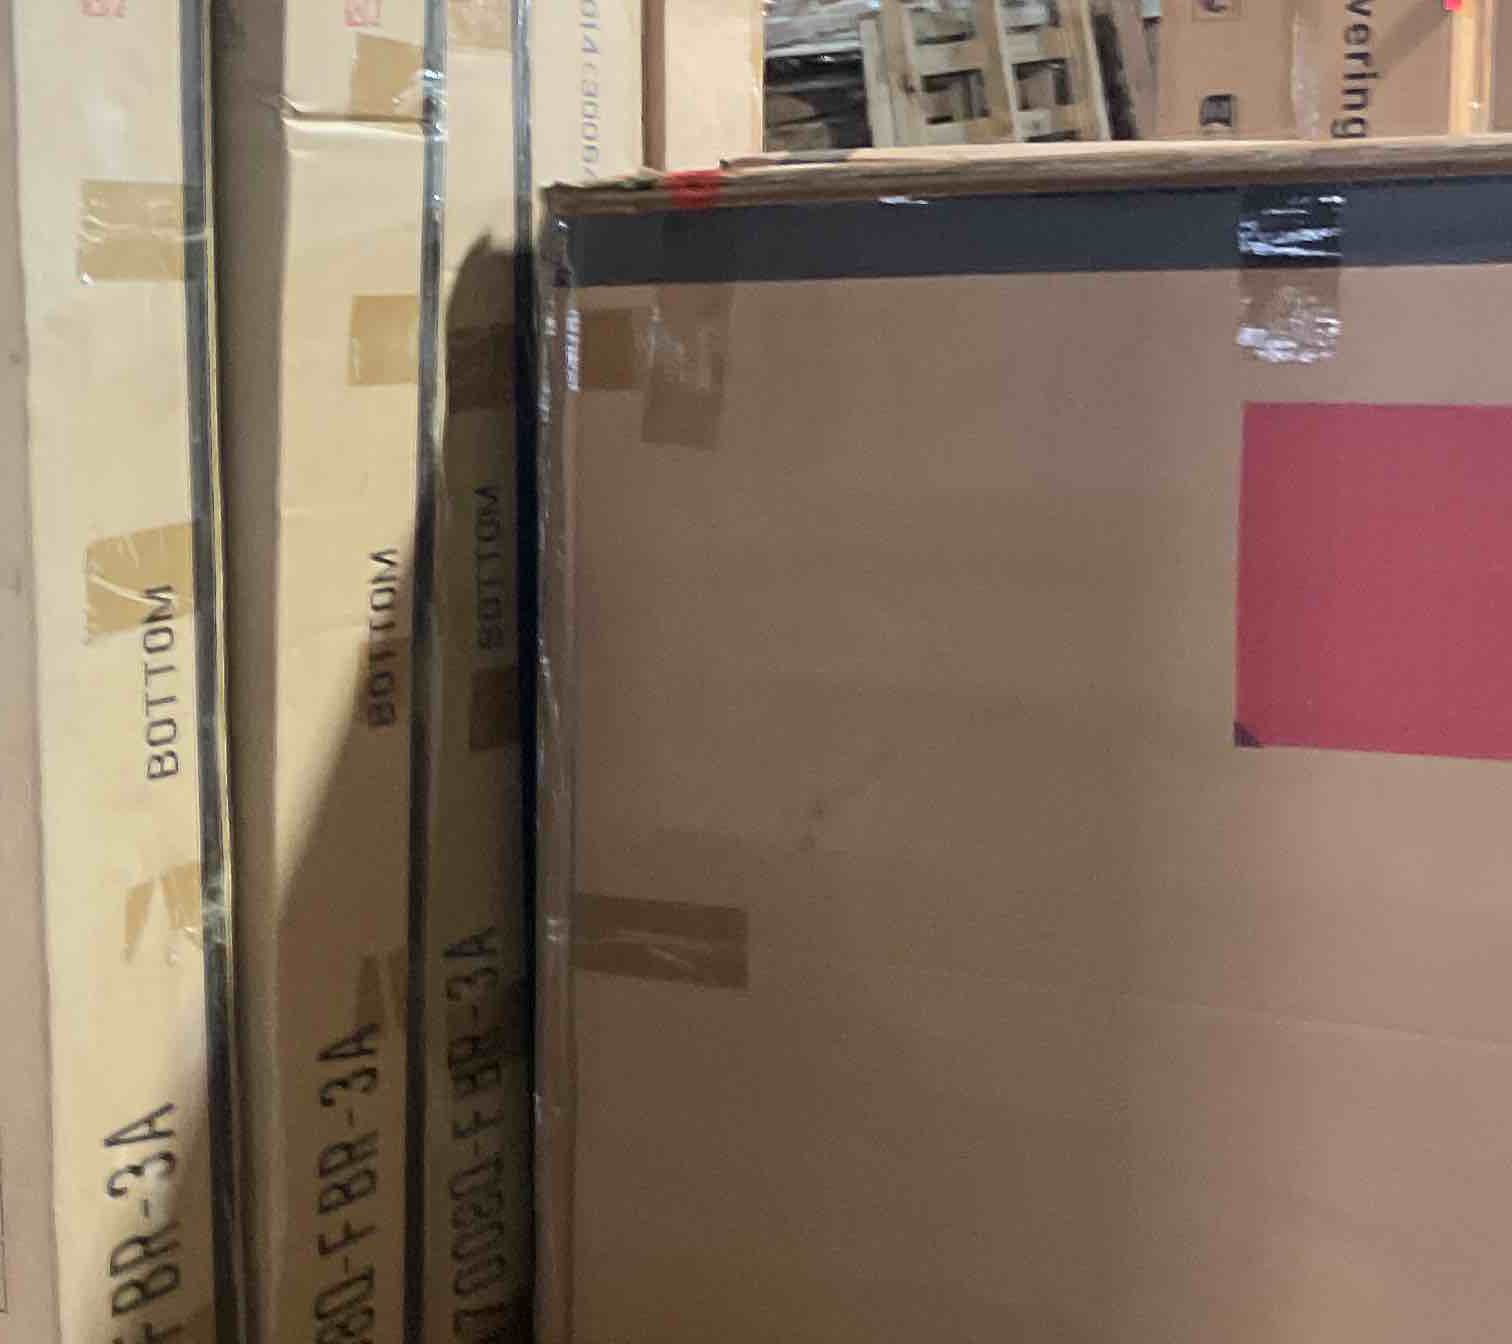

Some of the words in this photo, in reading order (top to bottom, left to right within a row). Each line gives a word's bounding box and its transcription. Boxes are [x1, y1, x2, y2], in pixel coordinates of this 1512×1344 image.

[367, 548, 399, 729] BOTTOM
[473, 486, 505, 651] BOTTOM
[144, 584, 181, 782] BOTTOM
